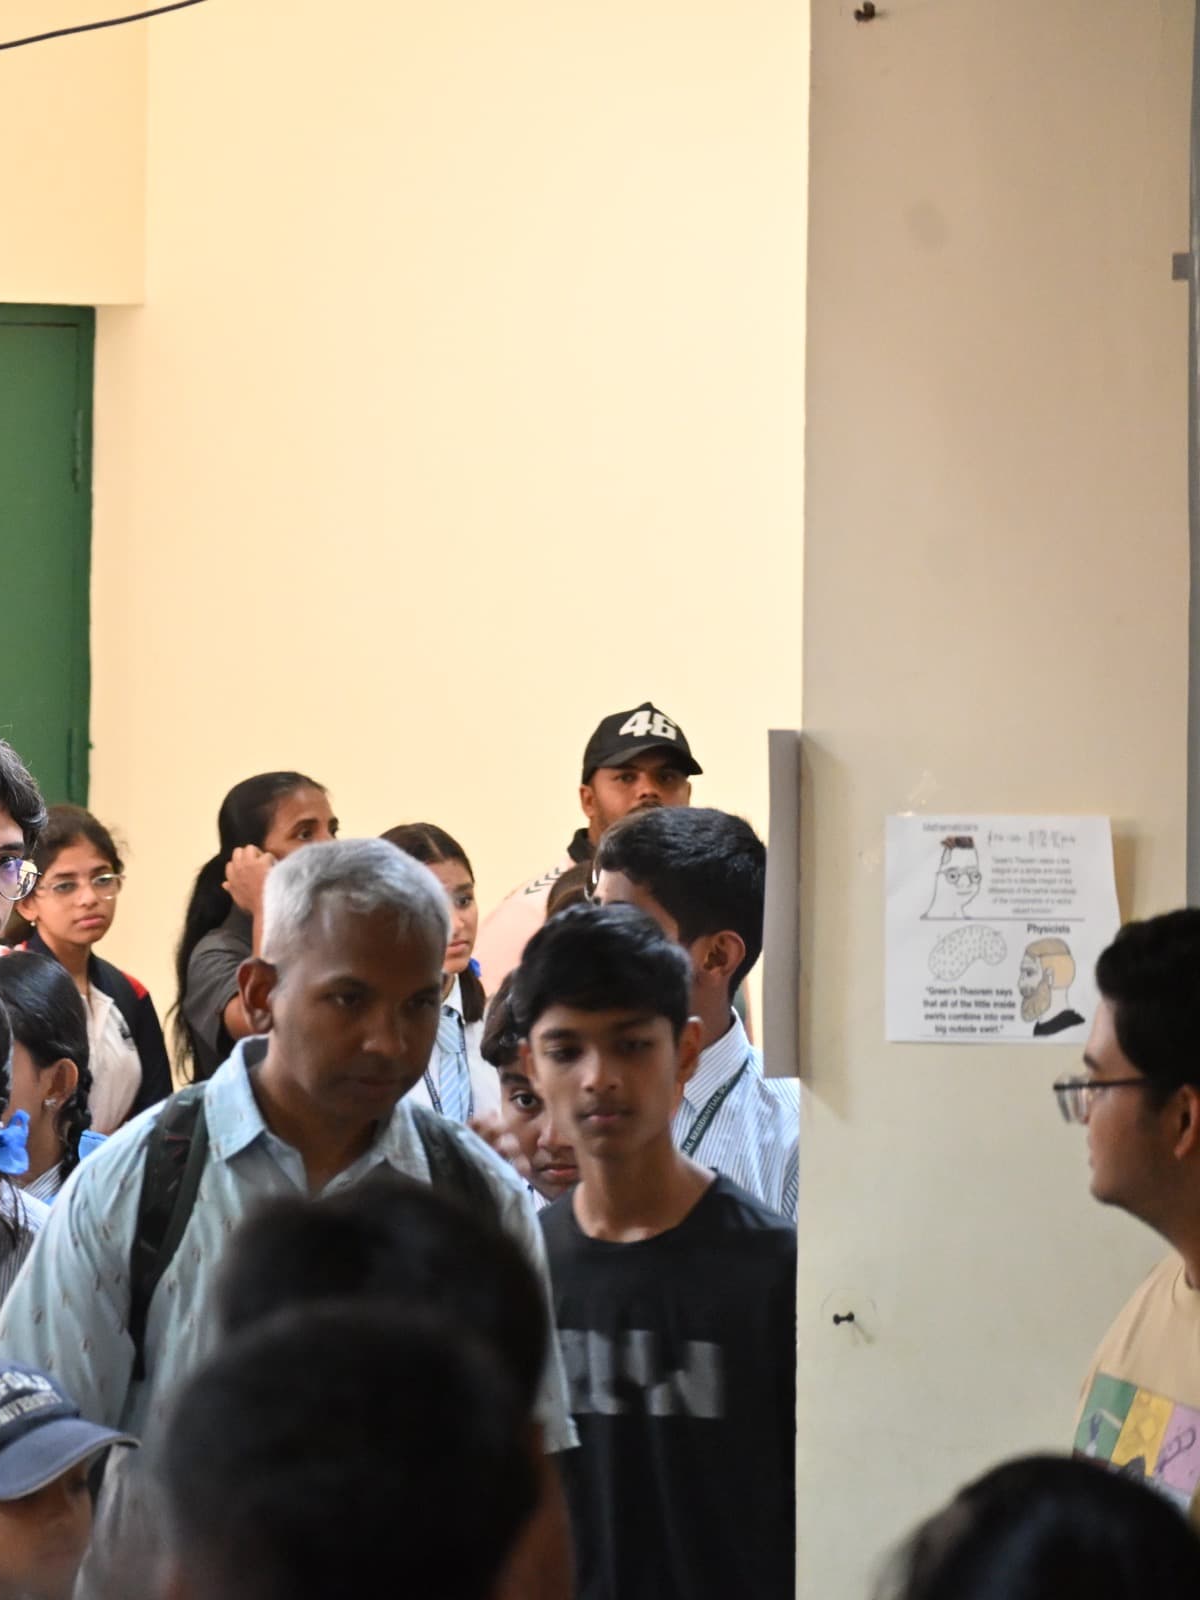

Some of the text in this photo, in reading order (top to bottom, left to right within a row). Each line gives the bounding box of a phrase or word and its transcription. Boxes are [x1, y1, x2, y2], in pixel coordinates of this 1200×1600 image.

[619, 710, 677, 740] 46
[1027, 923, 1071, 935] Physicists
[959, 986, 993, 996] Theorem
[995, 988, 1013, 998] says
[923, 999, 937, 1008] that
[940, 1000, 948, 1008] all
[950, 1000, 958, 1008] of
[960, 1000, 972, 1008] the
[948, 1012, 981, 1021] combine
[935, 1024, 946, 1034] big
